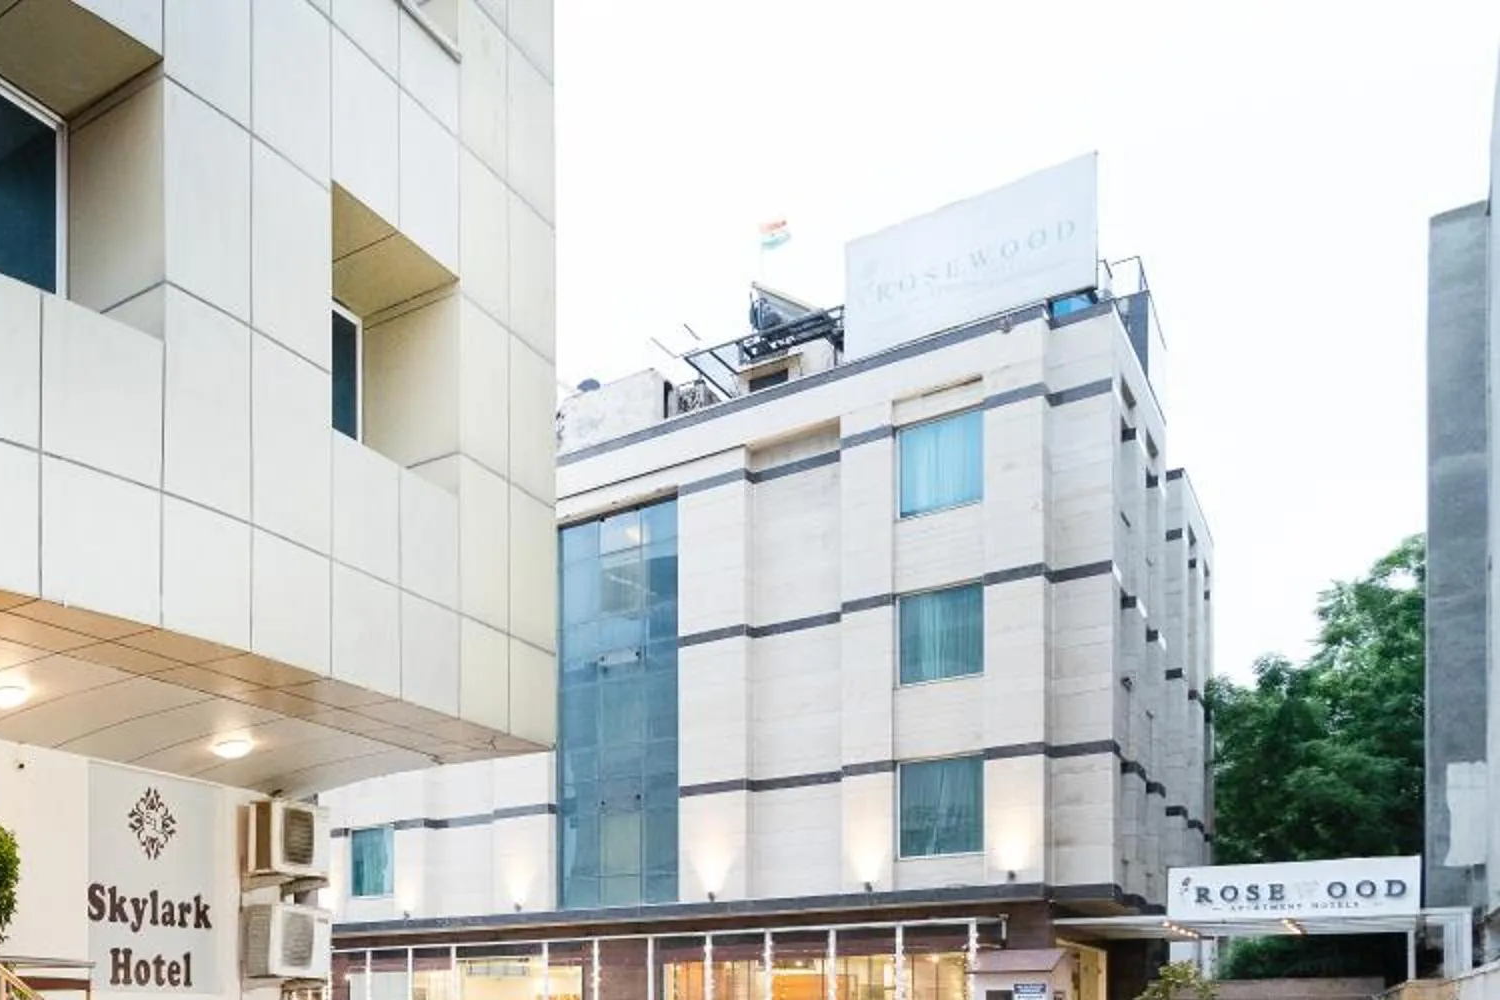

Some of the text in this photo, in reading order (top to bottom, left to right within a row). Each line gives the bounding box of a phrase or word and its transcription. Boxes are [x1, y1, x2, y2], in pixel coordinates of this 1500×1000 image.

[875, 219, 1076, 303] ROSEWOOD
[87, 882, 213, 933] Skylark
[109, 947, 193, 988] Hotel
